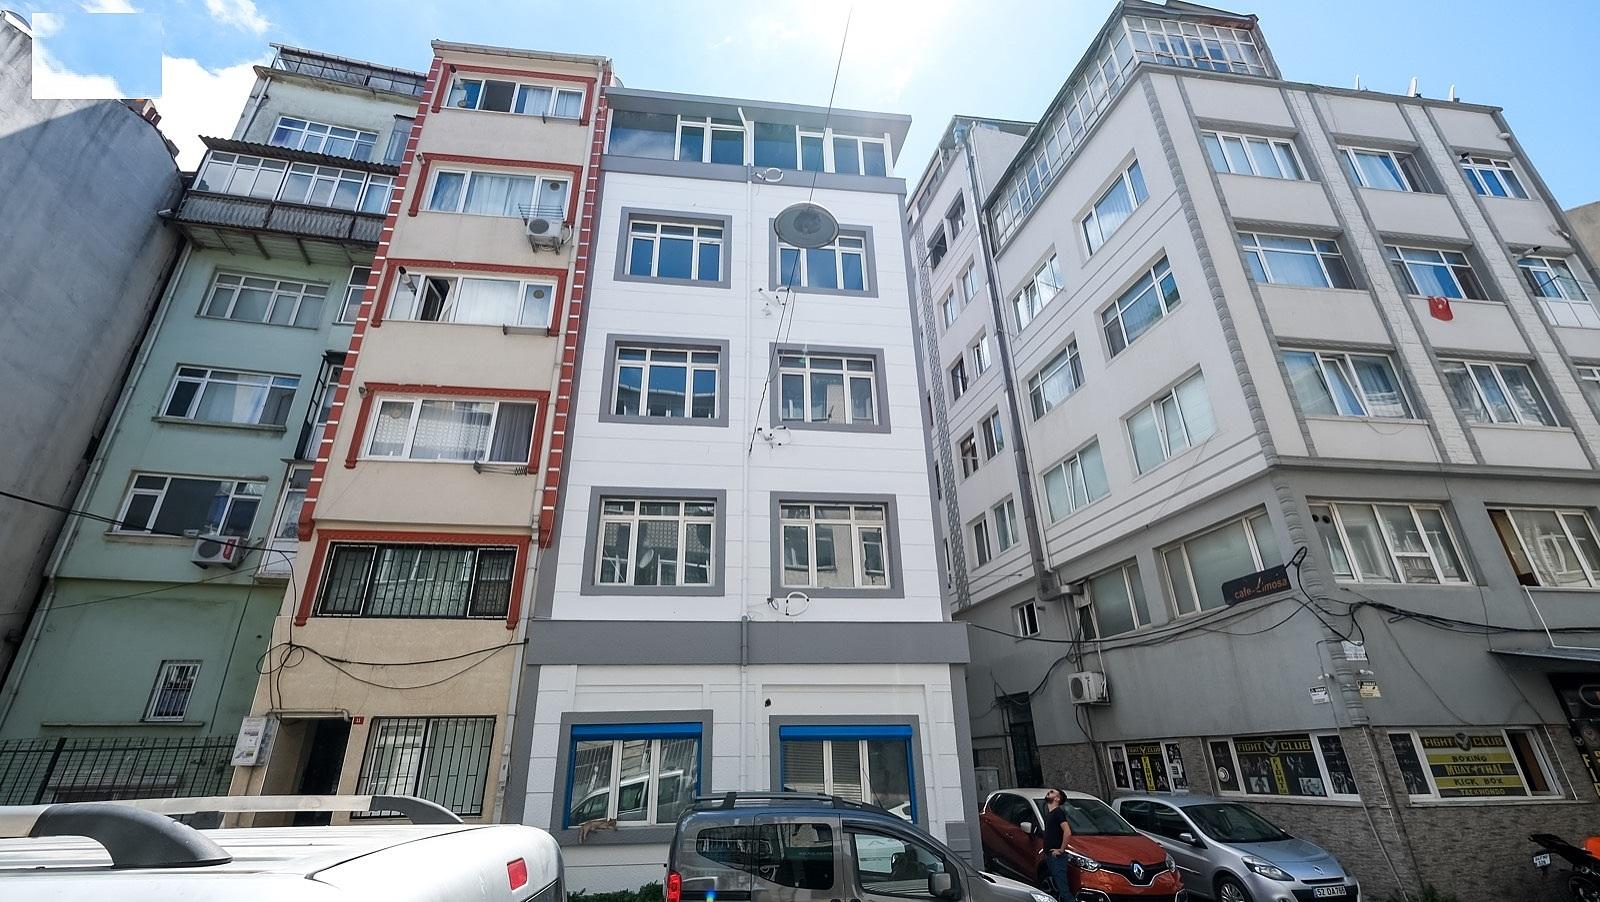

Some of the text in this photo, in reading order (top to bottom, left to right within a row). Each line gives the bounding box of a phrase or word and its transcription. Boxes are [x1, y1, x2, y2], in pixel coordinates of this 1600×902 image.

[1424, 736, 1504, 747] FIGHT CLUB
[1237, 741, 1311, 752] FIGHT CLUB
[1451, 754, 1488, 762] BOXING
[1444, 763, 1504, 776] MUAY THAI
[1454, 778, 1479, 786] KICK
[1460, 788, 1506, 796] TAEKWONDO
